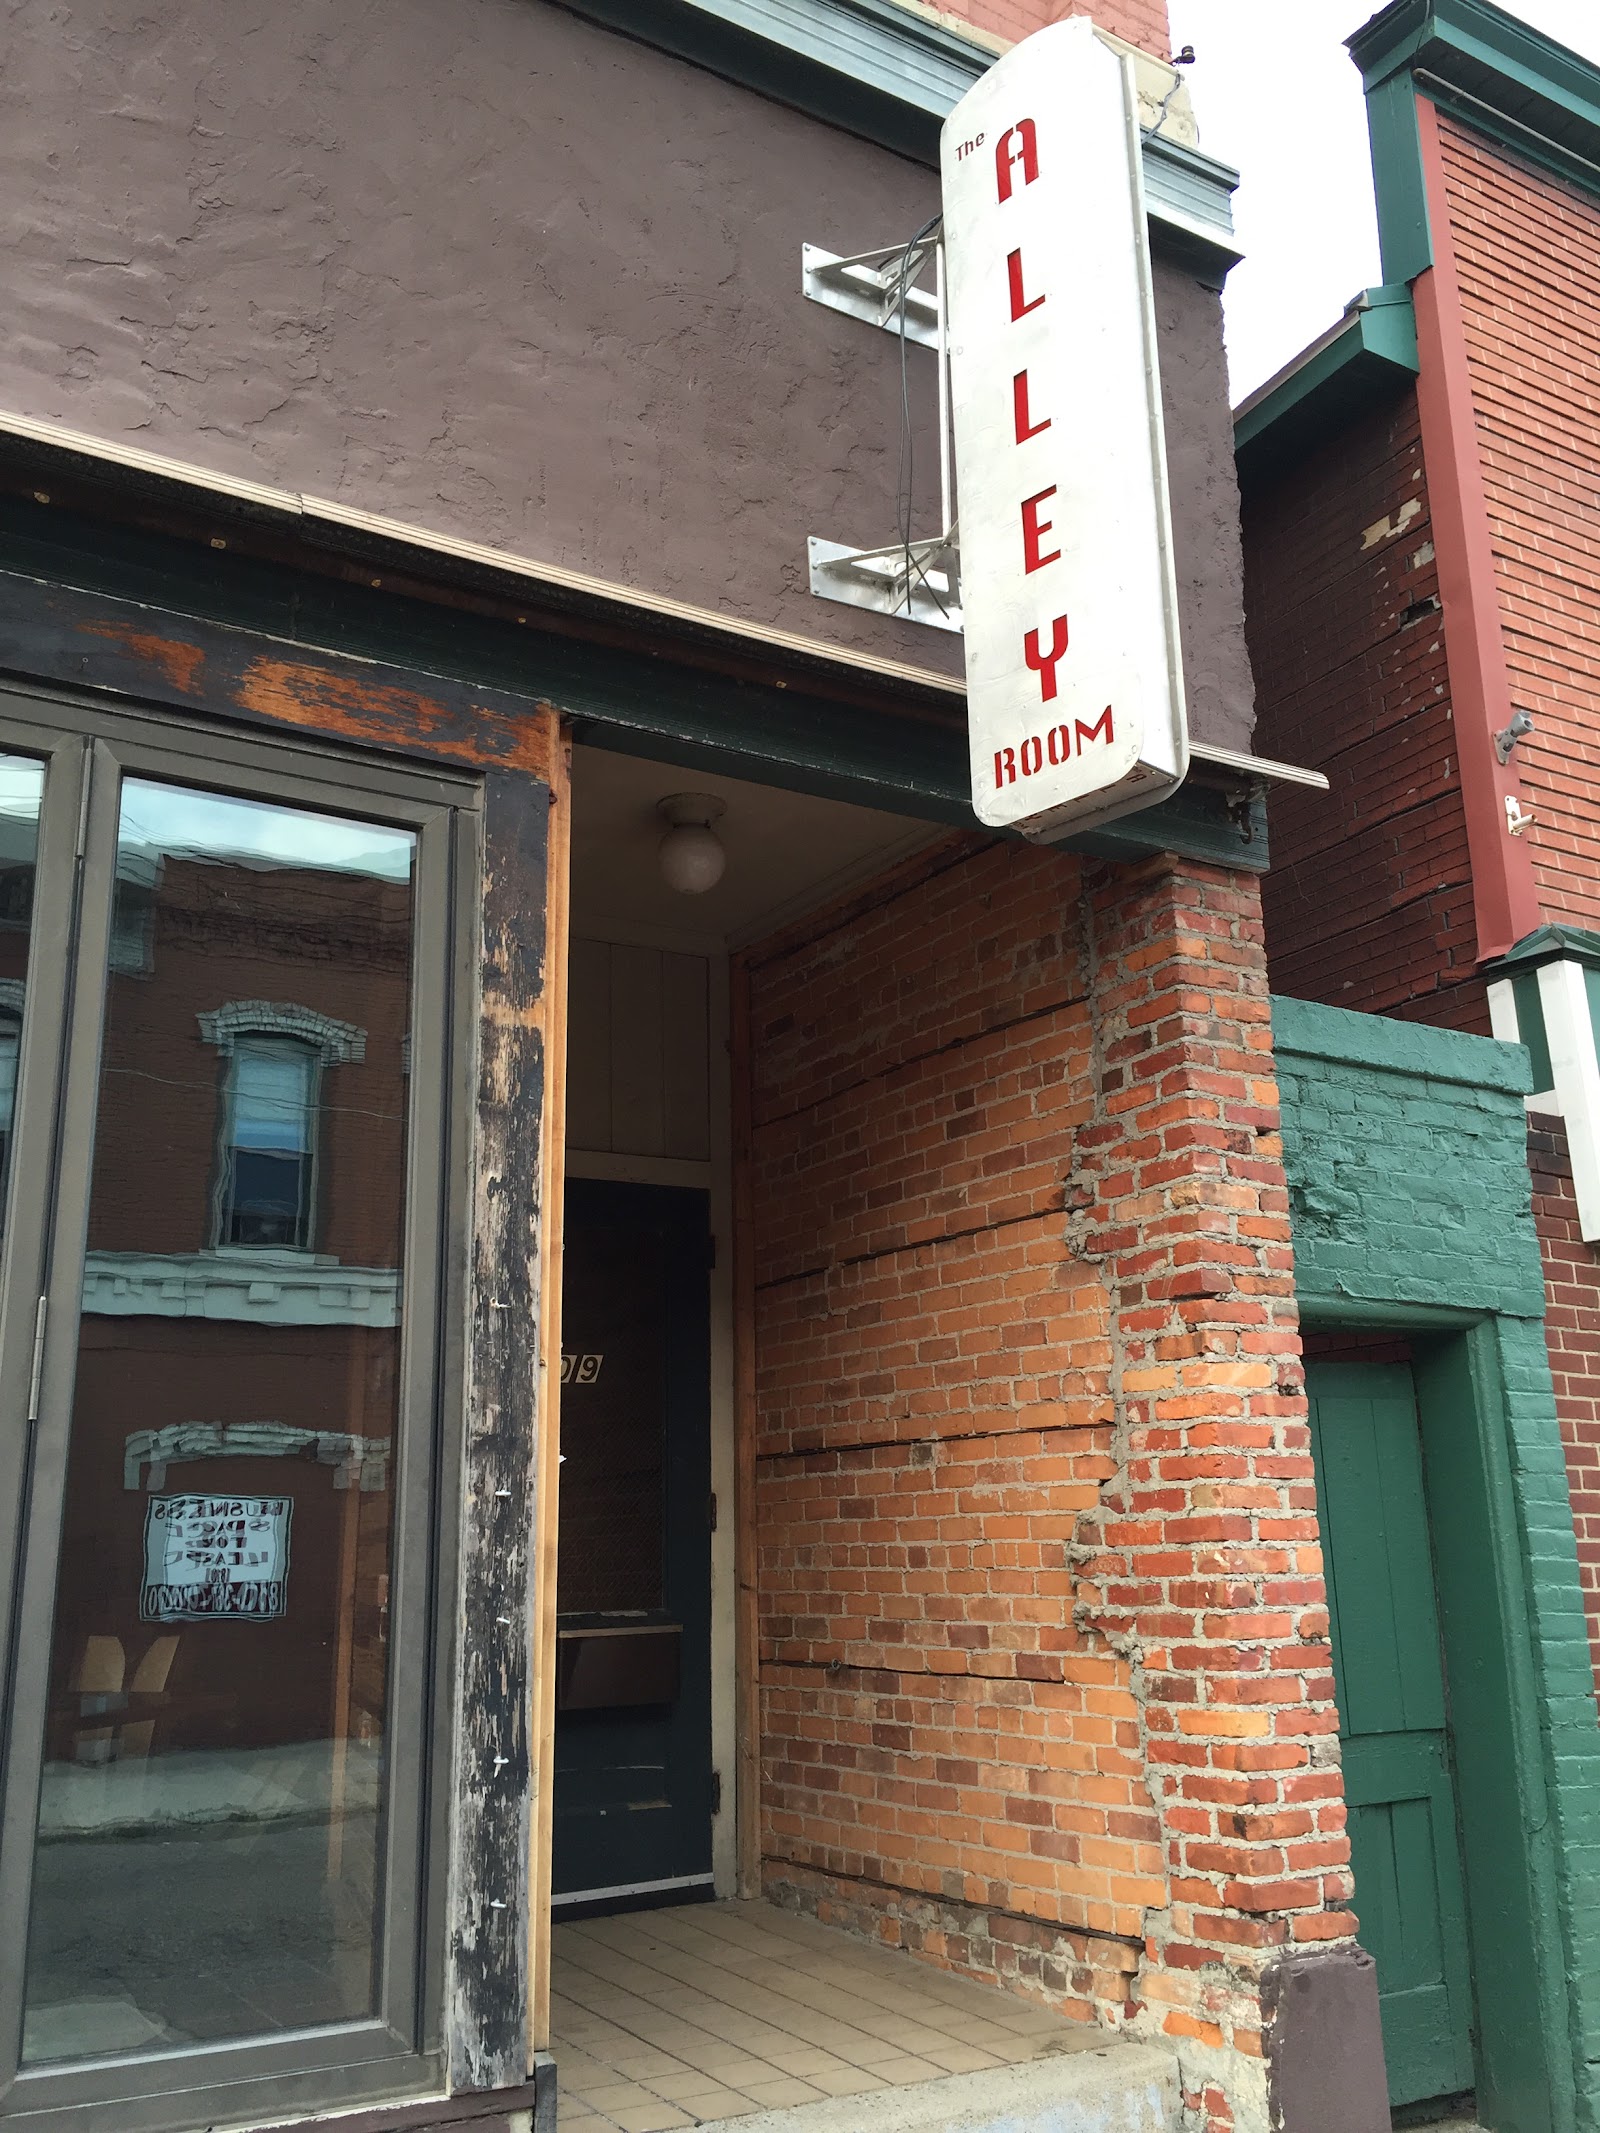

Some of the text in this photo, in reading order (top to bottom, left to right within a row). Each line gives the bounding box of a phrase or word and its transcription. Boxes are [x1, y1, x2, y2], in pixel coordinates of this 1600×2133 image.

[954, 132, 985, 162] The
[995, 118, 1069, 703] ALLEY
[994, 704, 1114, 789] ROOM
